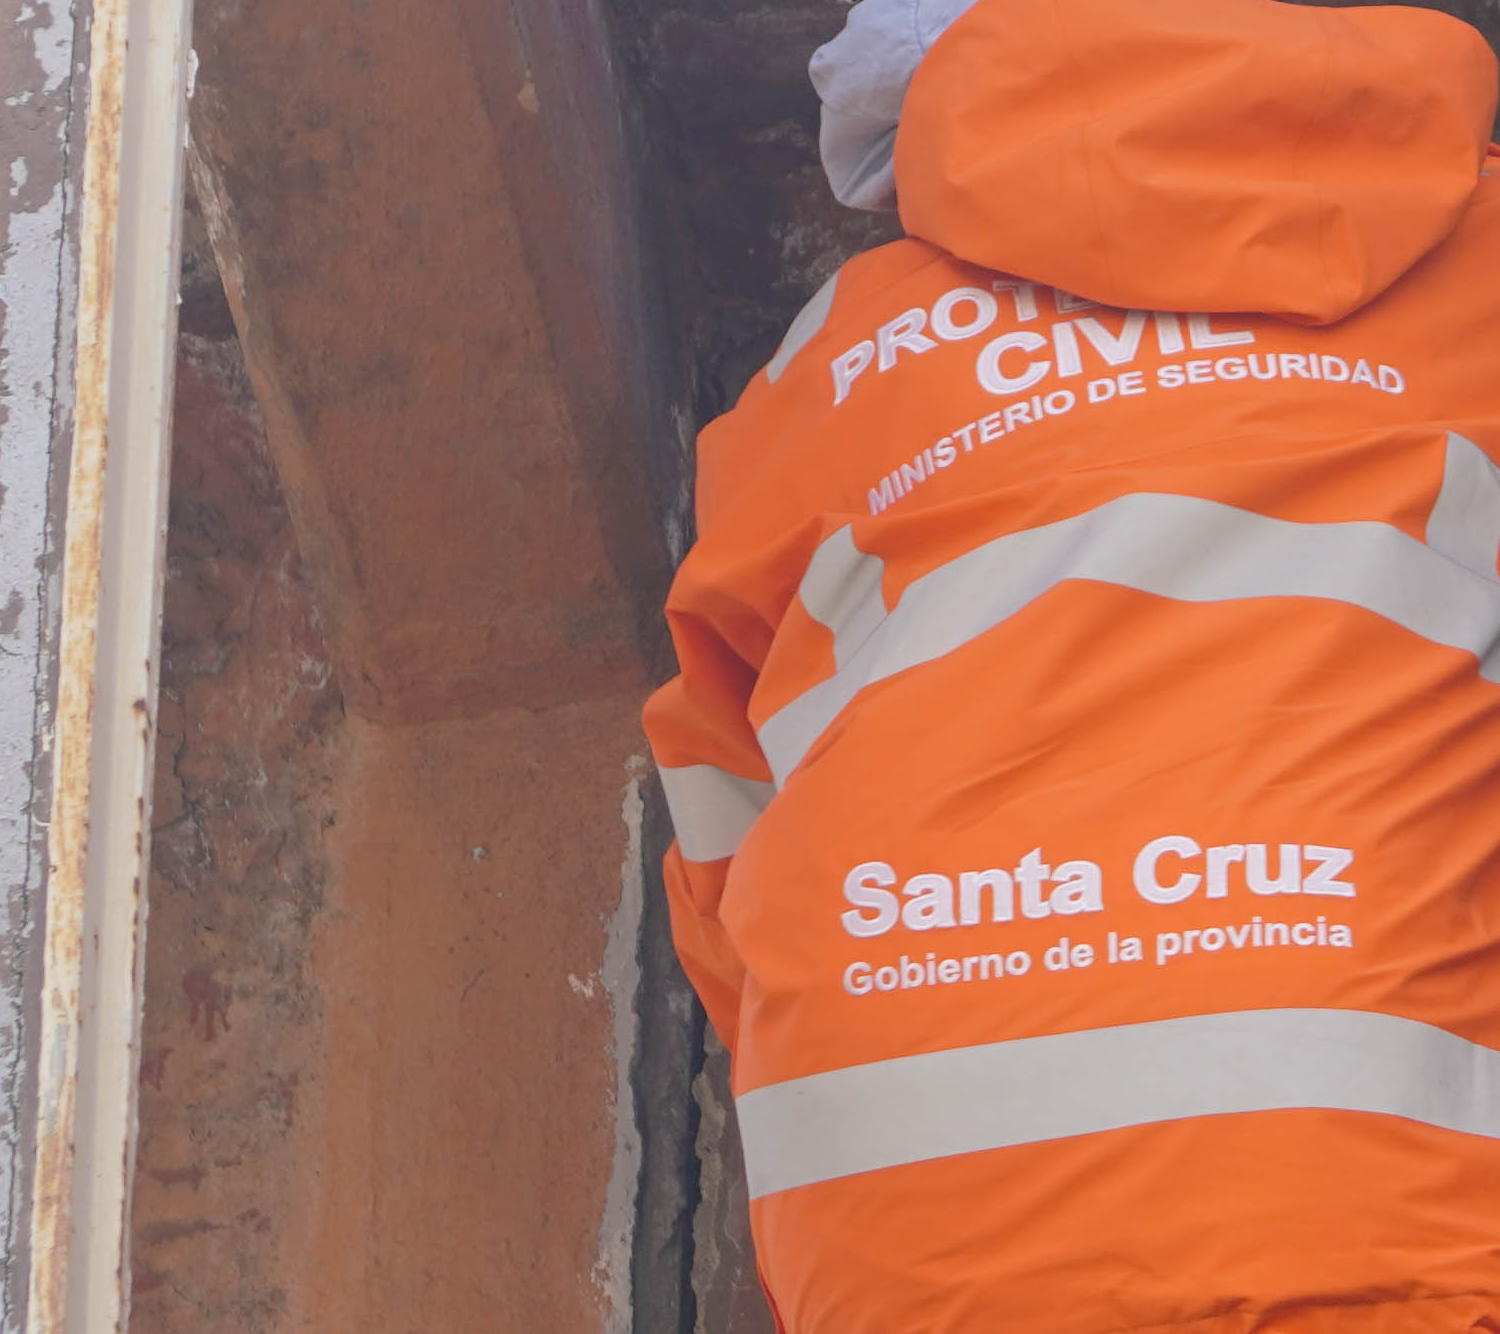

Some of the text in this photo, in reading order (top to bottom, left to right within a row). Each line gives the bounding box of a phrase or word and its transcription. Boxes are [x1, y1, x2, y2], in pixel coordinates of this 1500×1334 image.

[975, 309, 1256, 395] CIVIL
[867, 353, 1405, 516] MINISTERIO DE SEGURIDAD
[840, 834, 1357, 939] Santa Cruz
[842, 915, 1354, 996] Gobierno de la provincia
